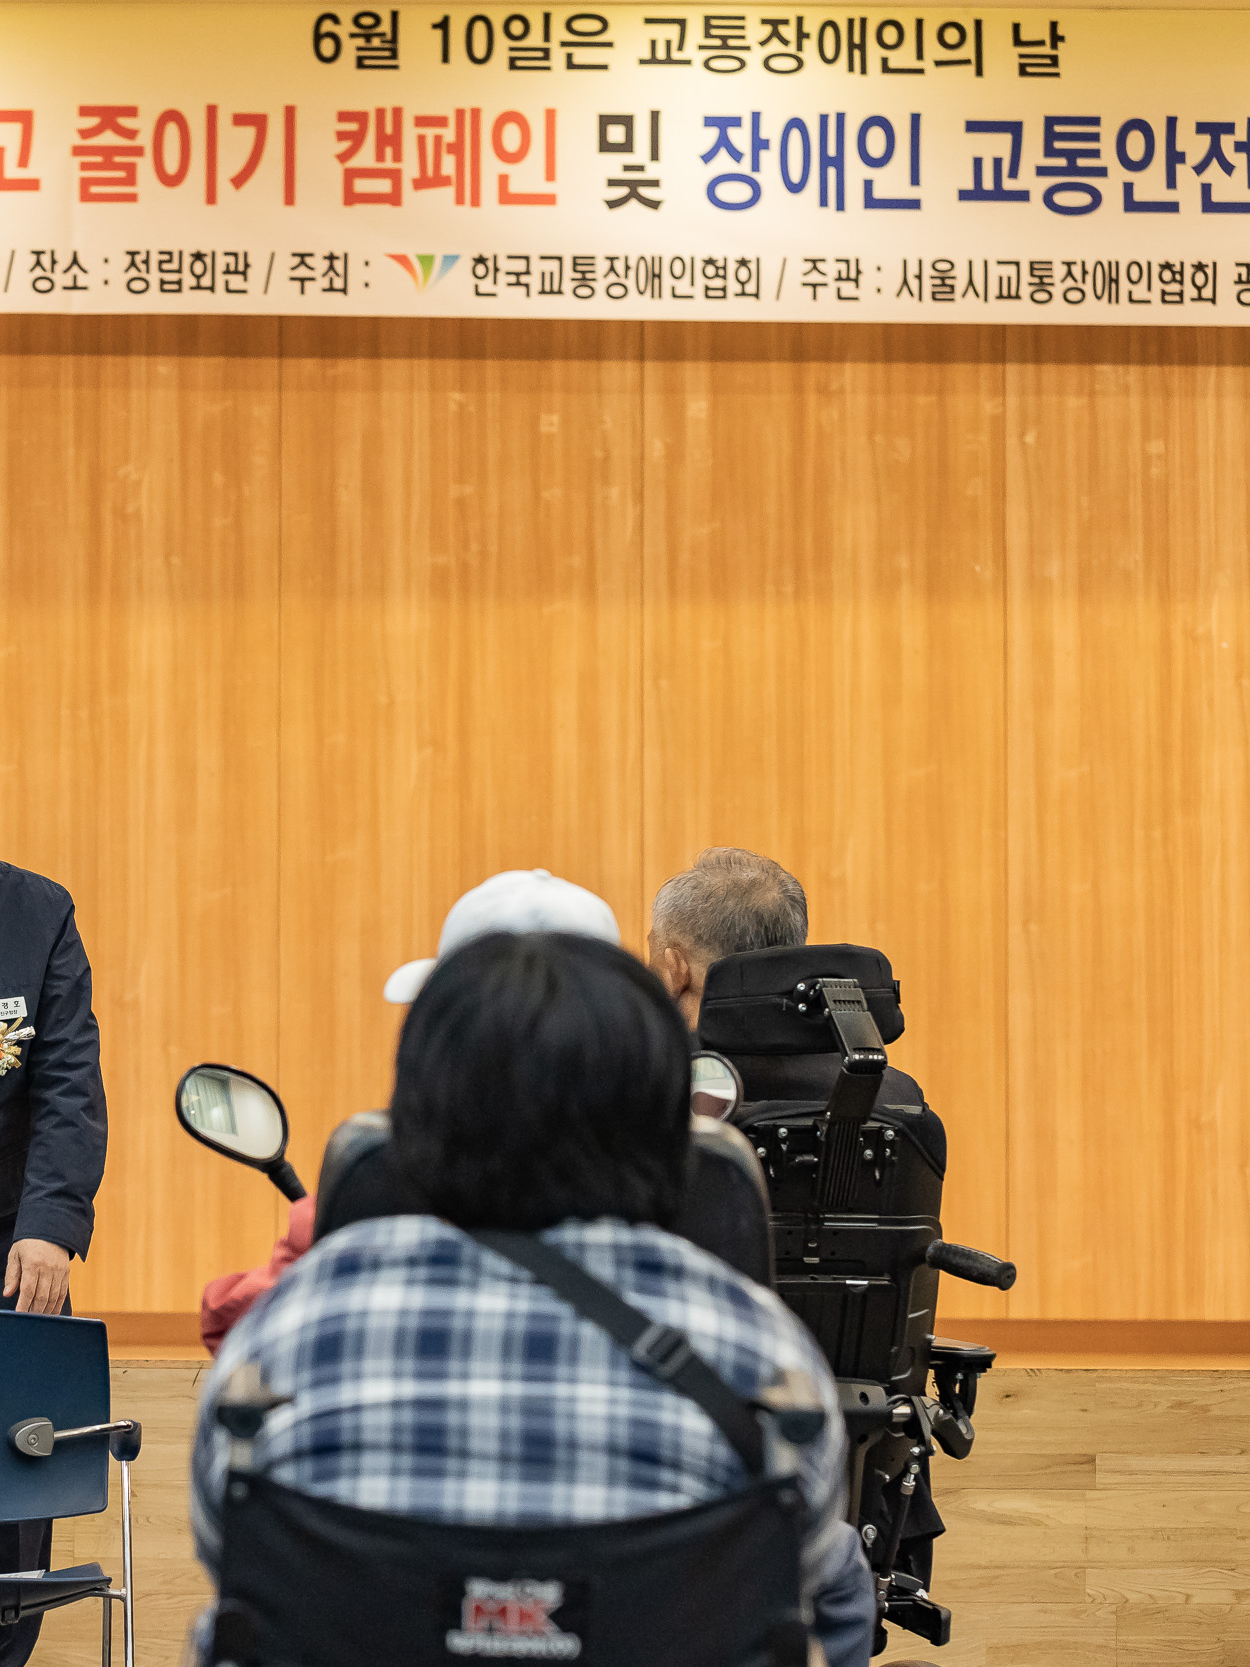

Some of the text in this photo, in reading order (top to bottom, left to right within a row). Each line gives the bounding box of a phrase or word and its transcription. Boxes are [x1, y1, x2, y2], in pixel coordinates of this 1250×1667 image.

[312, 9, 1066, 78] 6월 10일은 교통장애인의 날
[70, 103, 297, 207] 줄이기
[333, 105, 558, 208] 캠페인
[597, 110, 664, 211] 및
[699, 111, 923, 213] 장애인
[956, 112, 1250, 217] 교통안전
[29, 249, 89, 295] 장소
[124, 249, 251, 296] 정립회관
[288, 252, 349, 297] 주최
[471, 253, 761, 301] 한국교통장애인협회
[801, 257, 863, 302] 주관
[895, 258, 1218, 307] 서울시교통장애인협회
